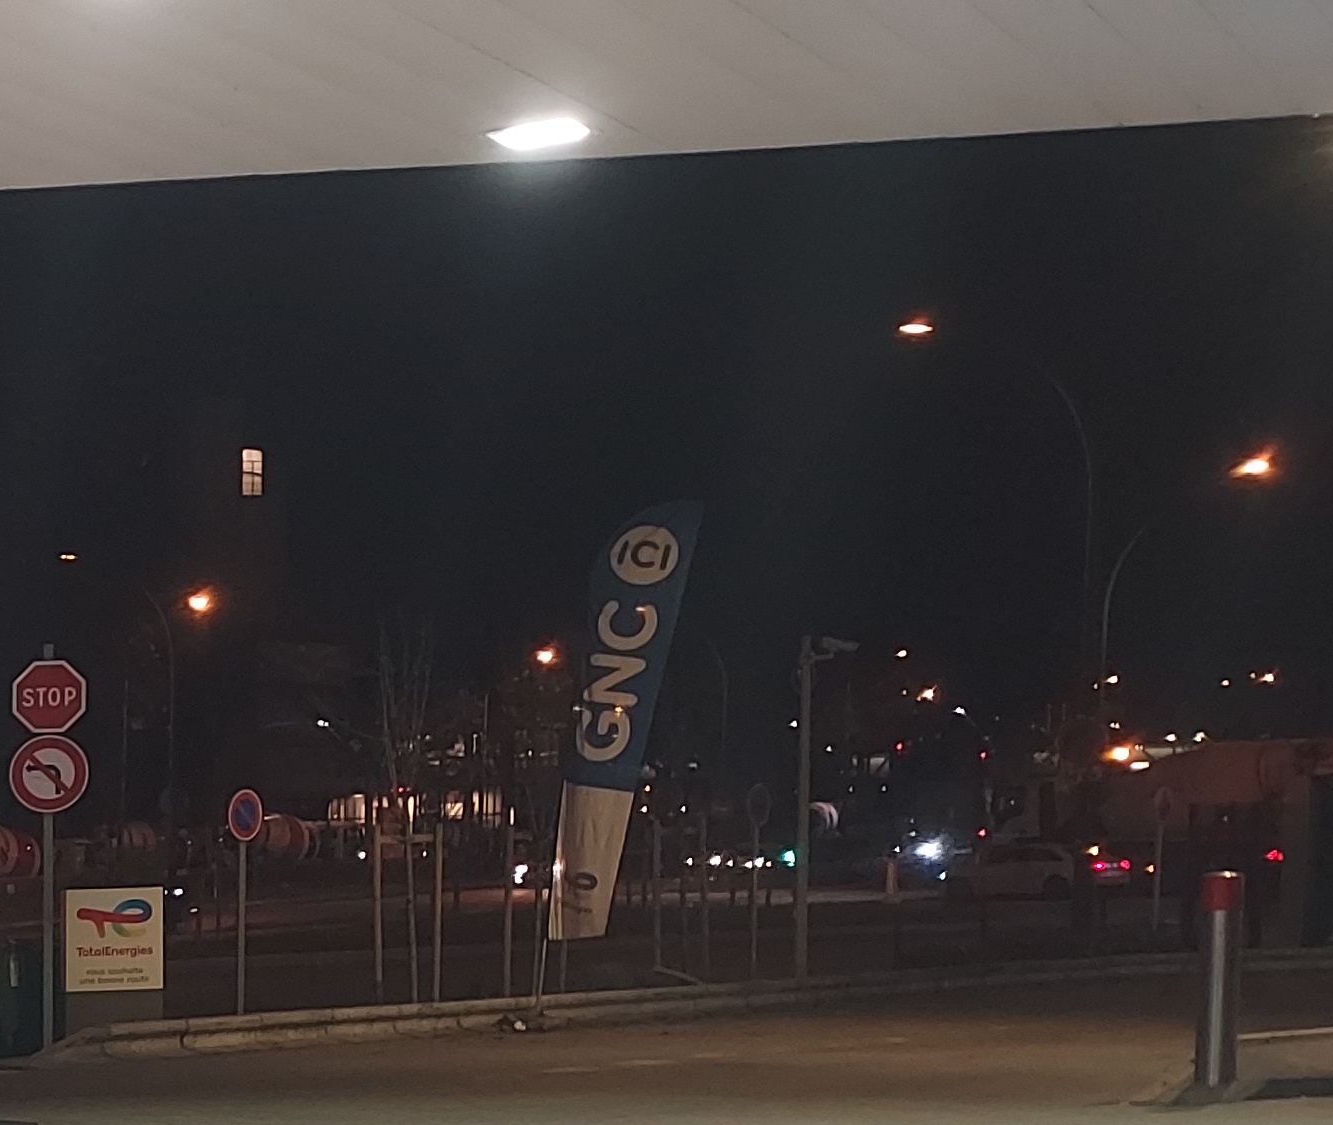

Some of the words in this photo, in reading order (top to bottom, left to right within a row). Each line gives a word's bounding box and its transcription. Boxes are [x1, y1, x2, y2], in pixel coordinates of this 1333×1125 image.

[616, 539, 672, 572] ICI
[576, 599, 659, 763] GNC
[22, 686, 77, 708] STOP
[76, 945, 154, 958] TotalEnergies
